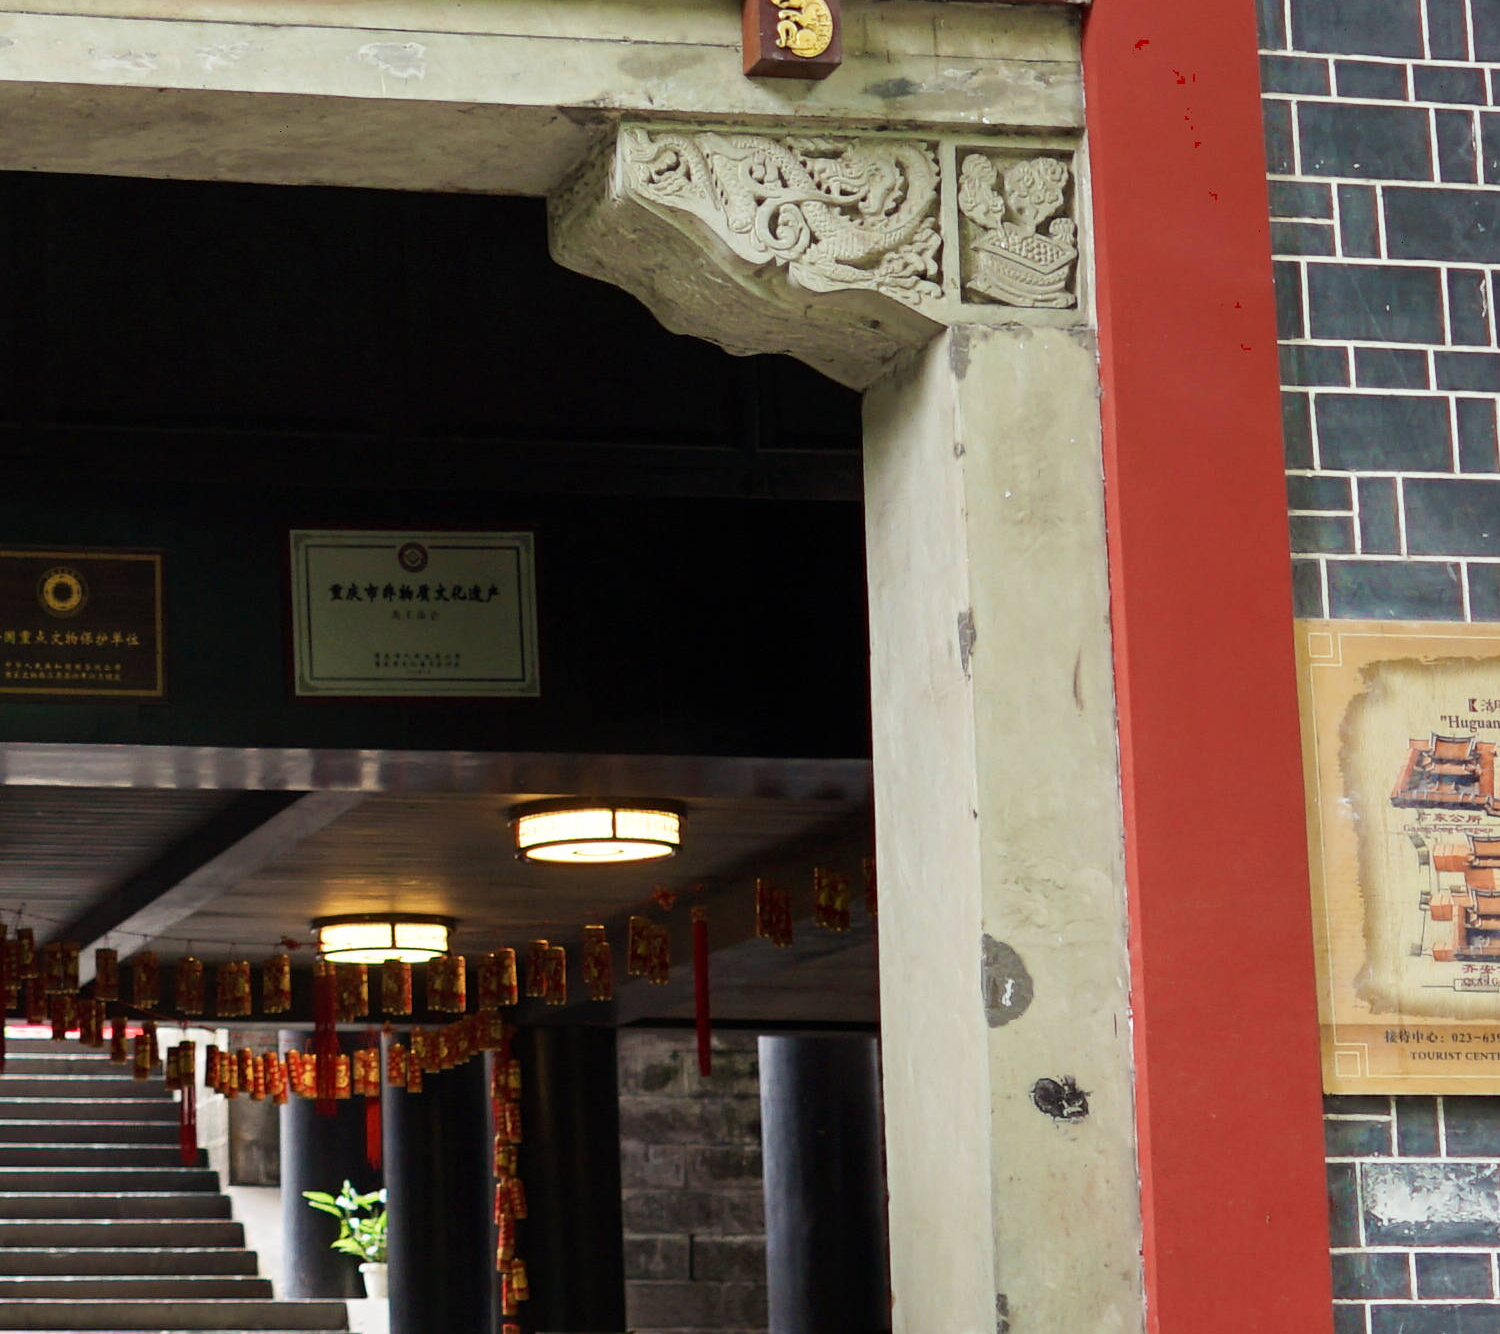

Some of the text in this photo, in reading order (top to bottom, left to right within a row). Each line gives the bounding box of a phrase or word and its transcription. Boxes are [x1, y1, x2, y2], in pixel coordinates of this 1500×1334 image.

[328, 582, 501, 603] 重庆市非物质文化遗产
[1410, 1051, 1462, 1061] TOURIST
